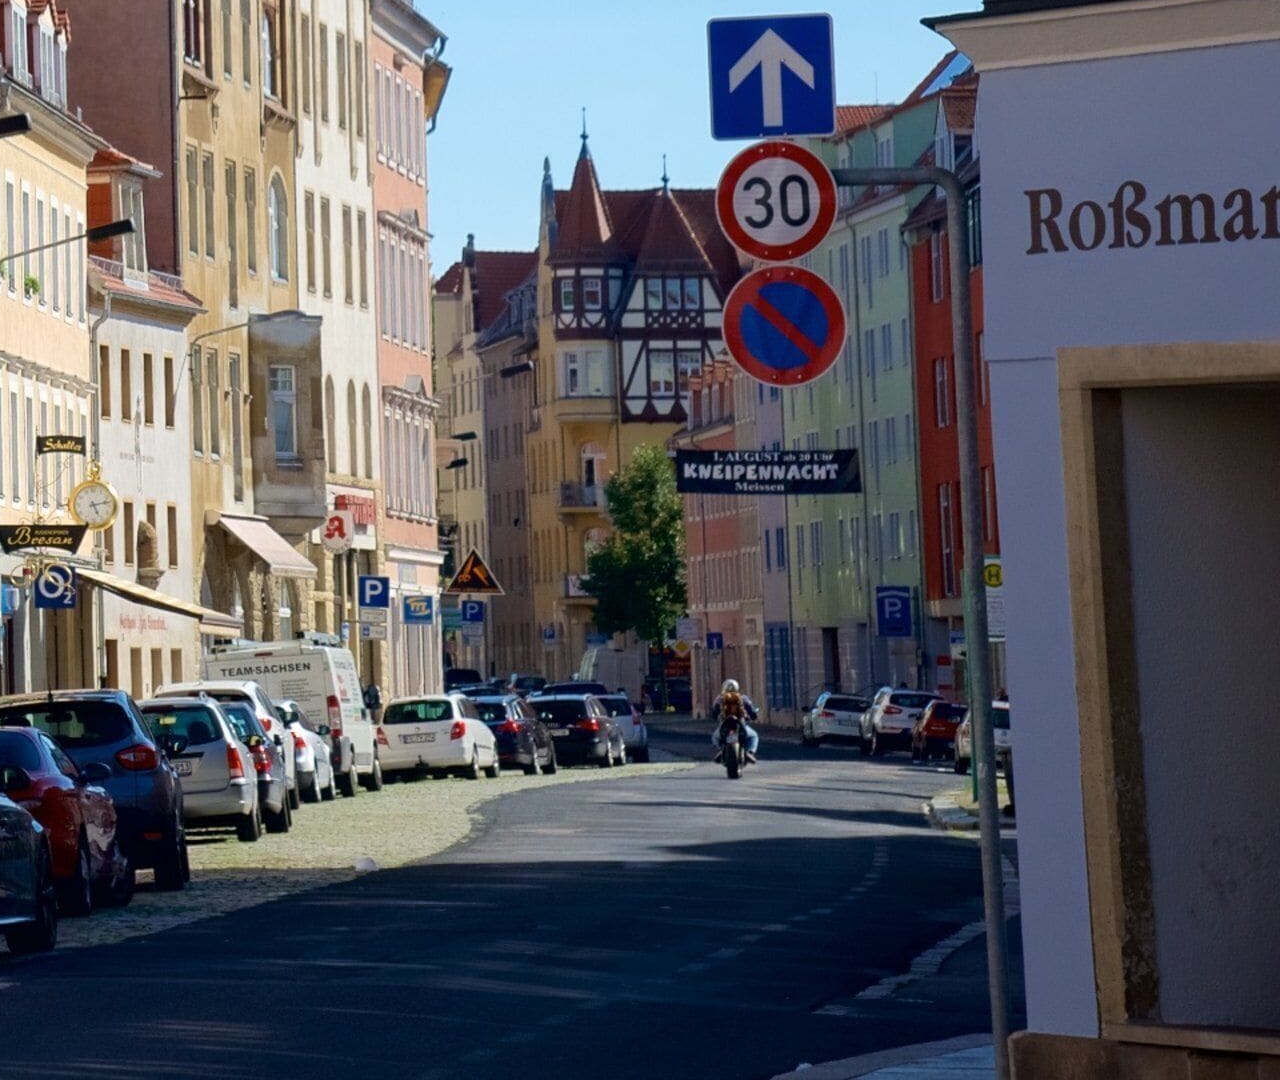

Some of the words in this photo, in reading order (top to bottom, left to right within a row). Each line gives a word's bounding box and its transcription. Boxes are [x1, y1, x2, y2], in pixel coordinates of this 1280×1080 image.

[743, 174, 810, 229] 30
[714, 452, 723, 461] 1.
[725, 452, 780, 462] AUGUST
[783, 453, 796, 461] ab
[799, 453, 811, 461] 20
[814, 453, 834, 461] Uhr
[683, 463, 839, 480] KNEIPENNACHT
[735, 482, 784, 492] Meissen
[365, 579, 383, 604] P
[466, 603, 479, 619] P
